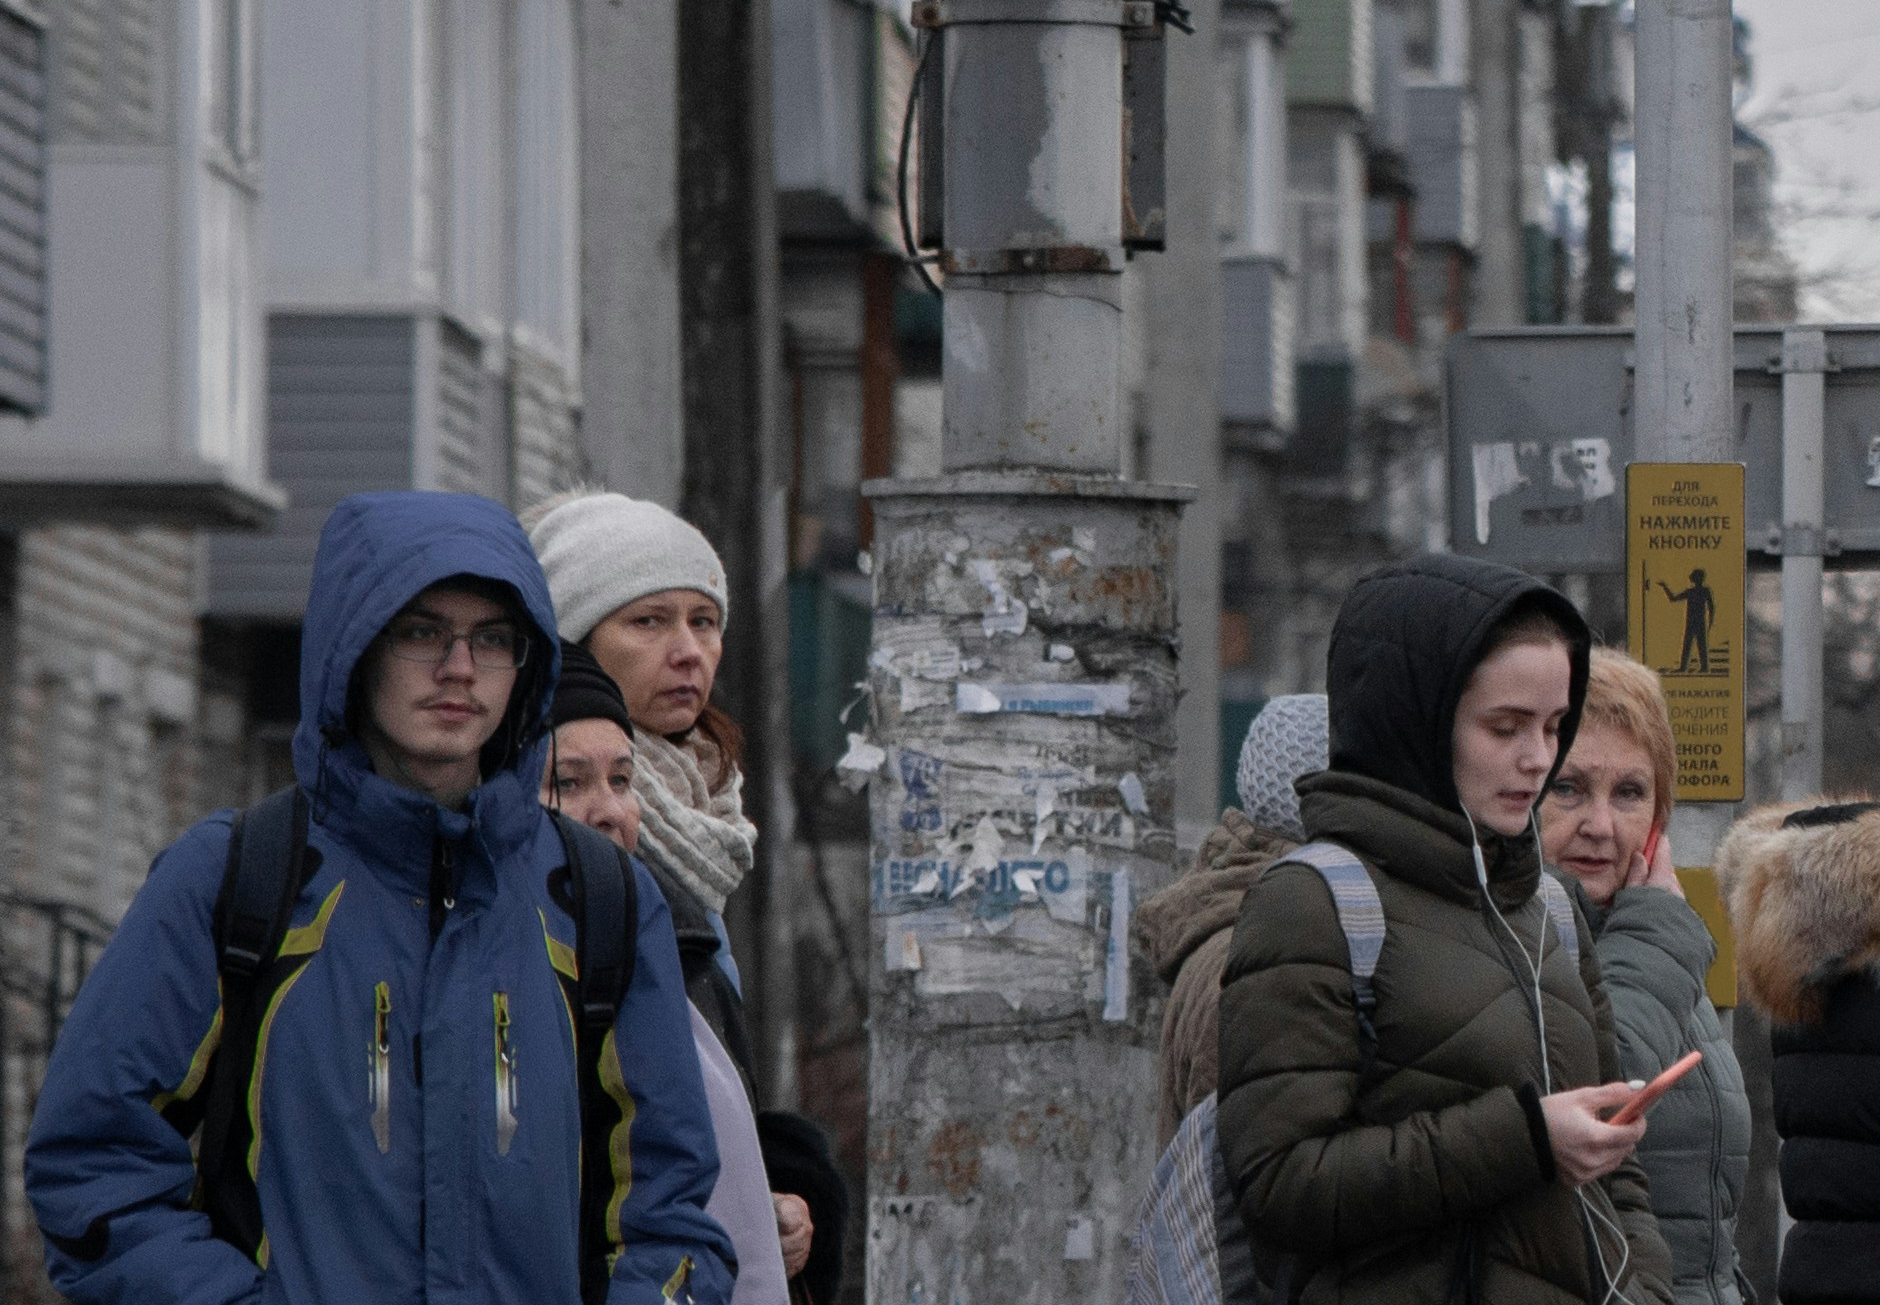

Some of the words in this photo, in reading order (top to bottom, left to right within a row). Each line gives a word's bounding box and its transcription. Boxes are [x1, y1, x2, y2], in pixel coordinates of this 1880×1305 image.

[1672, 480, 1700, 494] ДЛЯ
[1651, 496, 1719, 507] ПЕРЕХОДА
[1640, 516, 1731, 530] НАЖМИТЕ
[1648, 535, 1722, 550] КНОПКУ
[1670, 706, 1729, 719] ОЖДИТЕ
[1678, 759, 1719, 771] НАЛА
[1677, 775, 1730, 786] ОФОРА
